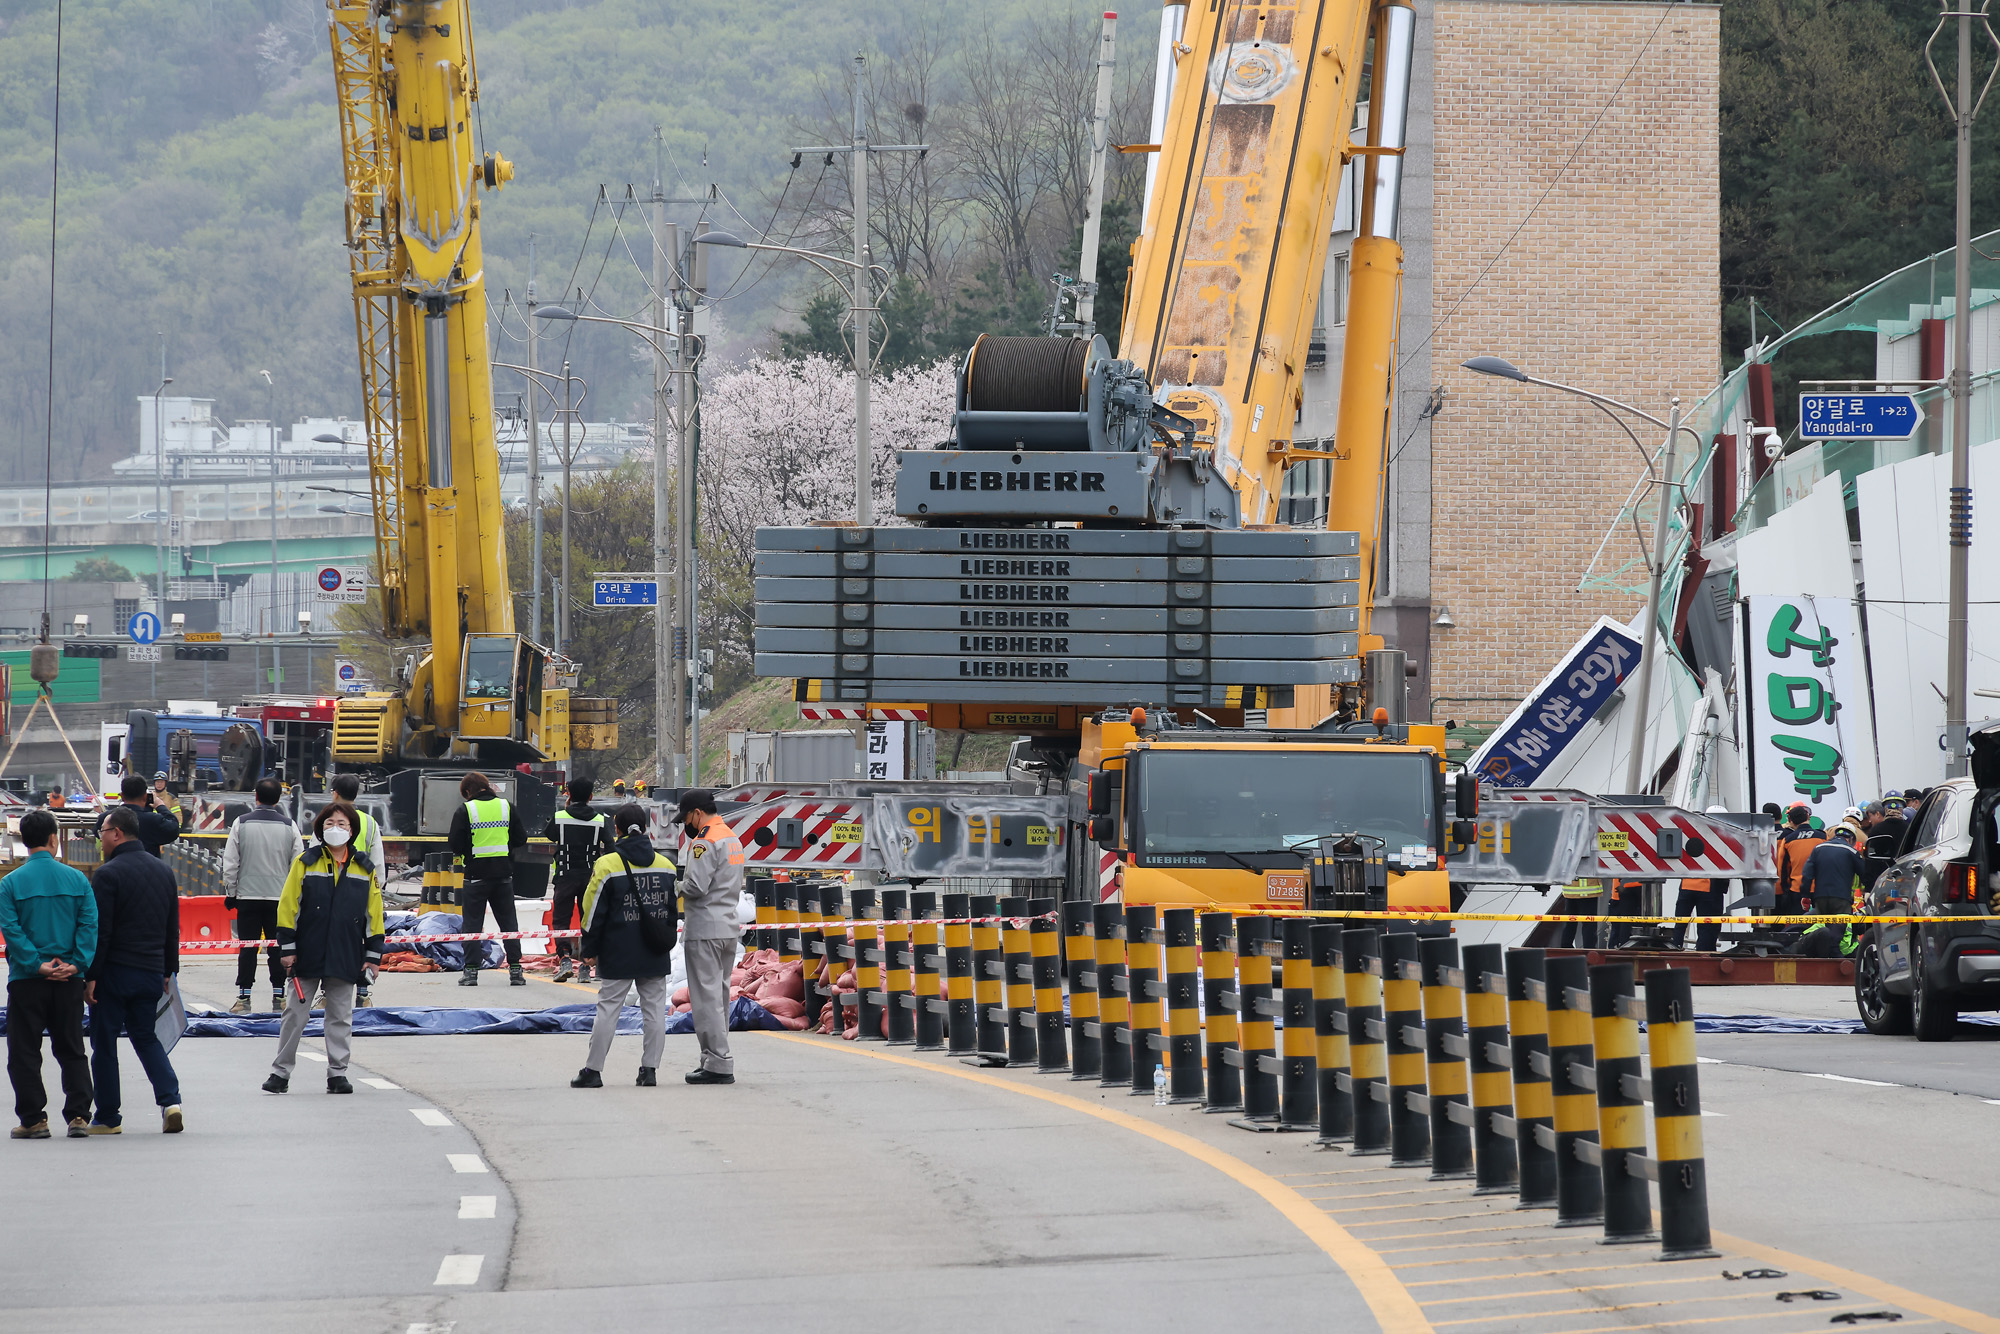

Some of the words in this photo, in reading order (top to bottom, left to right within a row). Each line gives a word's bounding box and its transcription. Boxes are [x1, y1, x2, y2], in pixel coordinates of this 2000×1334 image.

[1806, 399, 1866, 420] 양달로
[1896, 406, 1908, 416] 23
[1805, 420, 1874, 435] Yangdal-ro
[929, 471, 1106, 492] LIEBHERR
[960, 533, 1070, 549] LIEBHERR
[960, 559, 1071, 576] LIEBHERR
[598, 583, 633, 594] 오리로
[960, 584, 1070, 601] LIEBHERR
[605, 596, 626, 604] Ori-ro
[960, 610, 1070, 627] LIEBHERR
[960, 636, 1069, 652] LIEBHERR
[959, 661, 1069, 677] LIEBHERR
[1568, 635, 1631, 699] KCC
[1766, 603, 1844, 830] 산마루
[1504, 694, 1585, 769] 창호
[1797, 830, 1815, 839] 119
[1146, 856, 1207, 864] LIEBHERR
